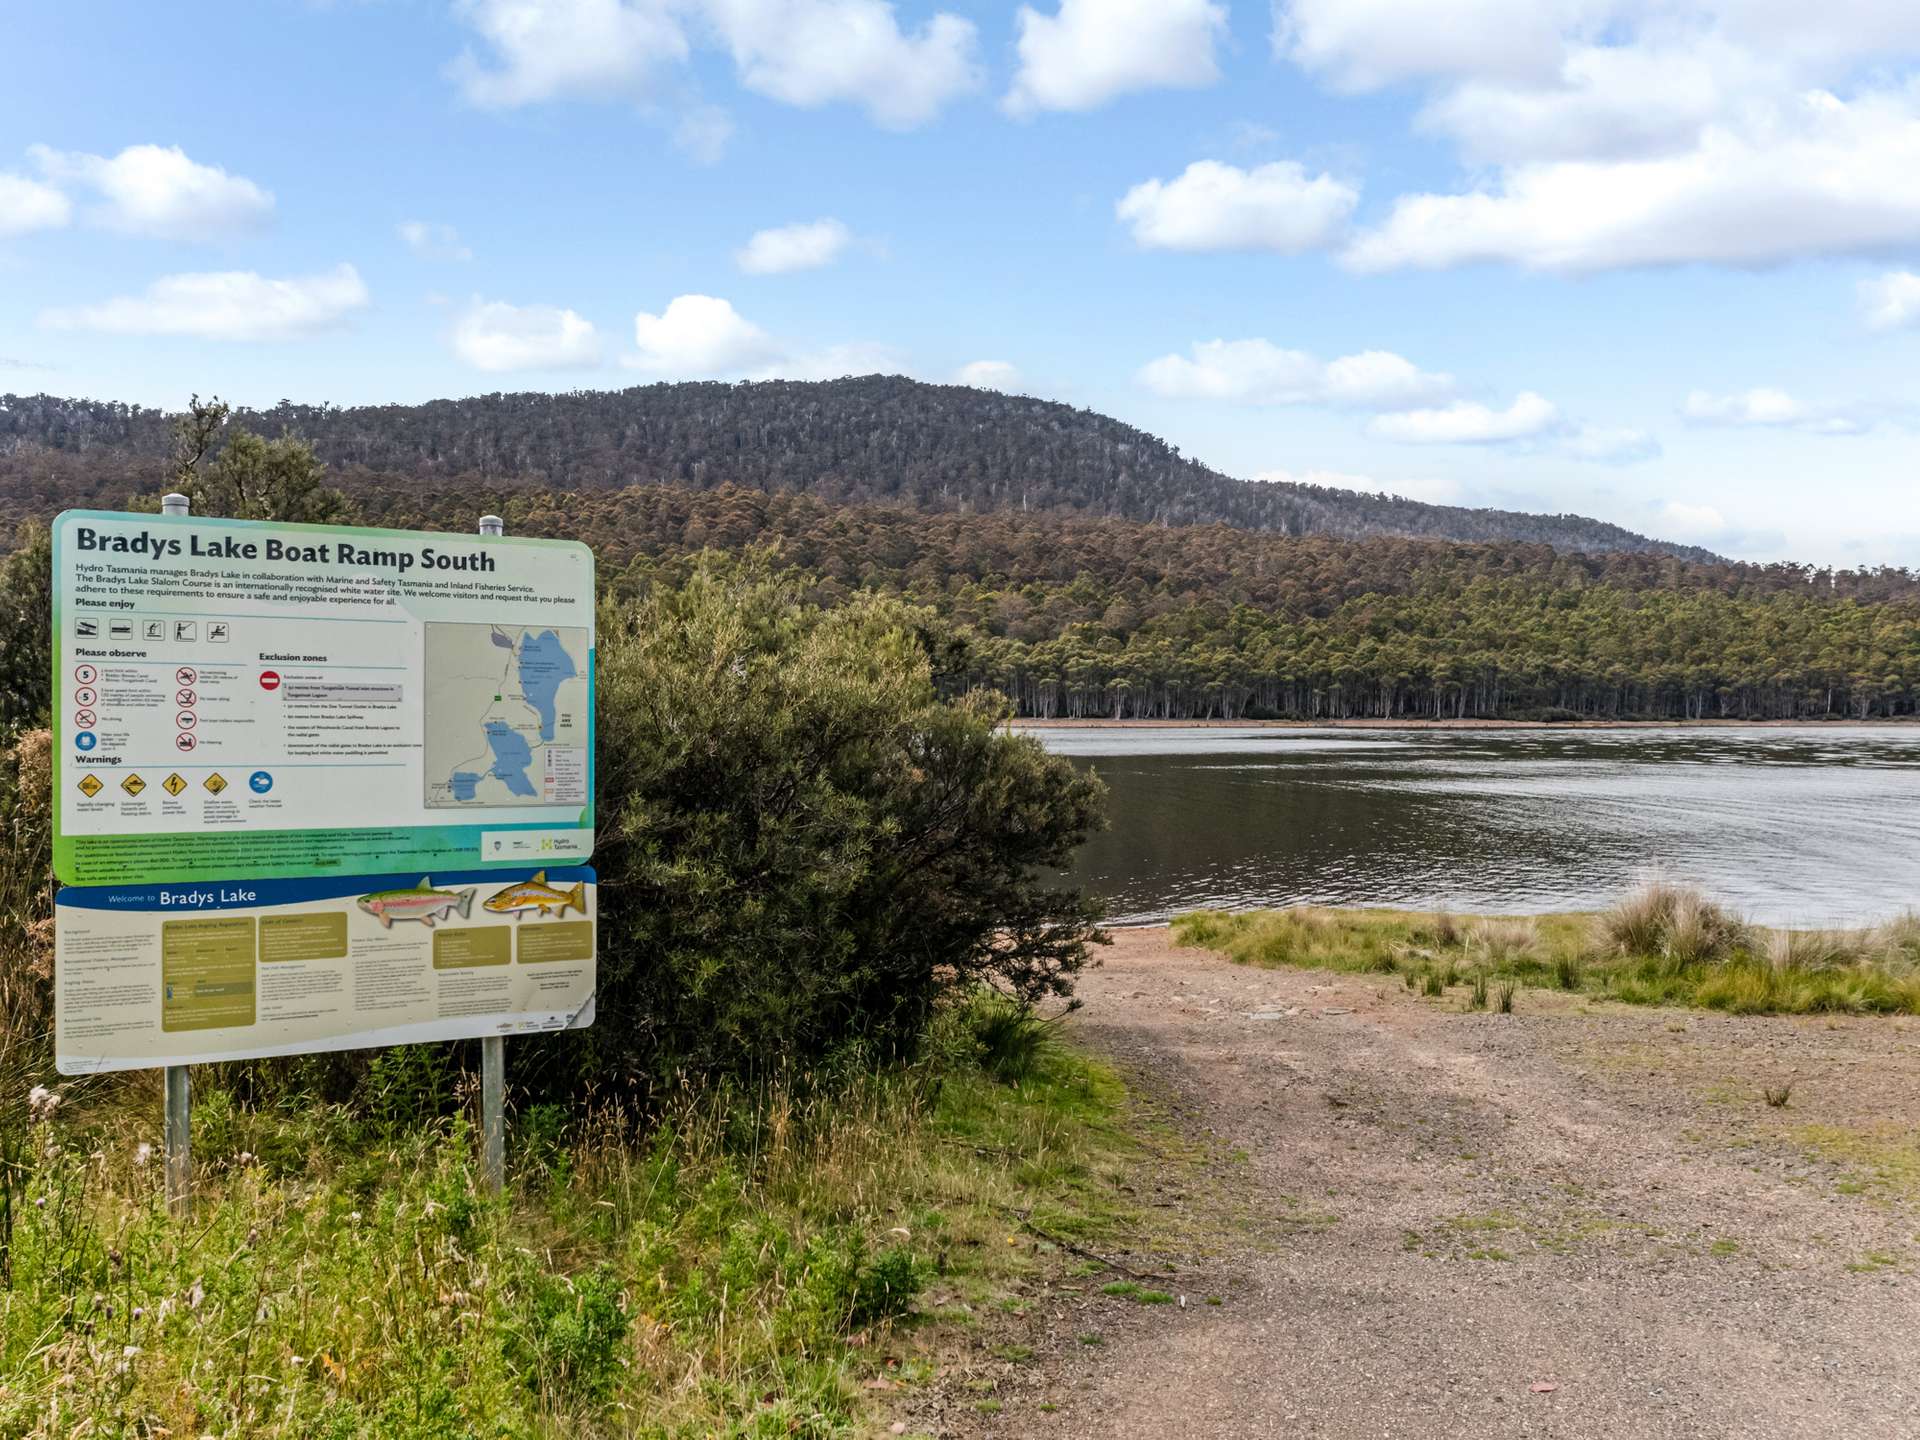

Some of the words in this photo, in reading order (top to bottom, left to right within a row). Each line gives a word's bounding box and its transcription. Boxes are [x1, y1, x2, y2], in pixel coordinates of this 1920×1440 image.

[77, 527, 181, 560] Bradys
[190, 535, 257, 559] Lake
[266, 539, 330, 563] Boat
[337, 543, 415, 573] Ramp
[421, 548, 495, 572] South
[75, 563, 104, 574] Hydro
[106, 564, 148, 575] Tasmania
[150, 568, 188, 578] manages
[190, 568, 218, 579] Bradys
[221, 569, 241, 579] Lake
[242, 572, 250, 580] in
[252, 572, 305, 582] collaboration
[306, 575, 324, 583] with
[326, 576, 354, 585] Marine
[355, 577, 370, 586] and
[371, 578, 396, 588] Safety
[398, 579, 433, 589] Tasmania
[434, 581, 449, 589] and
[450, 582, 473, 590] Inland
[475, 583, 506, 592] Fisheries
[507, 584, 535, 593] Service.
[75, 584, 107, 593] adhere
[109, 586, 118, 594] to
[120, 586, 144, 595] these
[146, 588, 204, 598] requirements
[206, 590, 215, 599] to
[216, 592, 245, 600] ensure
[253, 592, 271, 601] safe
[272, 593, 287, 601] and
[289, 594, 327, 604] enjoyable
[329, 596, 372, 606] experience
[373, 597, 384, 605] for
[386, 598, 397, 606] all.
[76, 573, 94, 583] The
[96, 574, 127, 585] Bradys
[128, 576, 149, 585] Lake
[151, 577, 180, 587] Slalom
[182, 578, 212, 588] Course
[214, 580, 221, 588] is
[222, 581, 233, 589] an
[235, 581, 294, 592] internationally
[295, 585, 338, 595] recognised
[340, 587, 361, 595] white
[363, 588, 385, 596] water
[386, 588, 402, 597] site.
[404, 588, 417, 597] We
[418, 590, 451, 599] welcome
[453, 591, 479, 600] visitors
[480, 592, 494, 601] and
[495, 594, 522, 604] request
[523, 595, 538, 603] that
[539, 597, 552, 605] you
[553, 596, 576, 605] please
[75, 598, 107, 608] Please
[109, 600, 135, 610] enjoy
[75, 648, 107, 657] Please
[108, 649, 147, 658] observe
[259, 652, 301, 662] Exclusion
[302, 654, 328, 662] zones
[82, 670, 89, 679] 5
[82, 692, 89, 701] 5
[75, 755, 122, 765] Warnings
[108, 895, 145, 904] Welcome
[160, 890, 215, 907] Bradys
[220, 889, 257, 903] Lake
